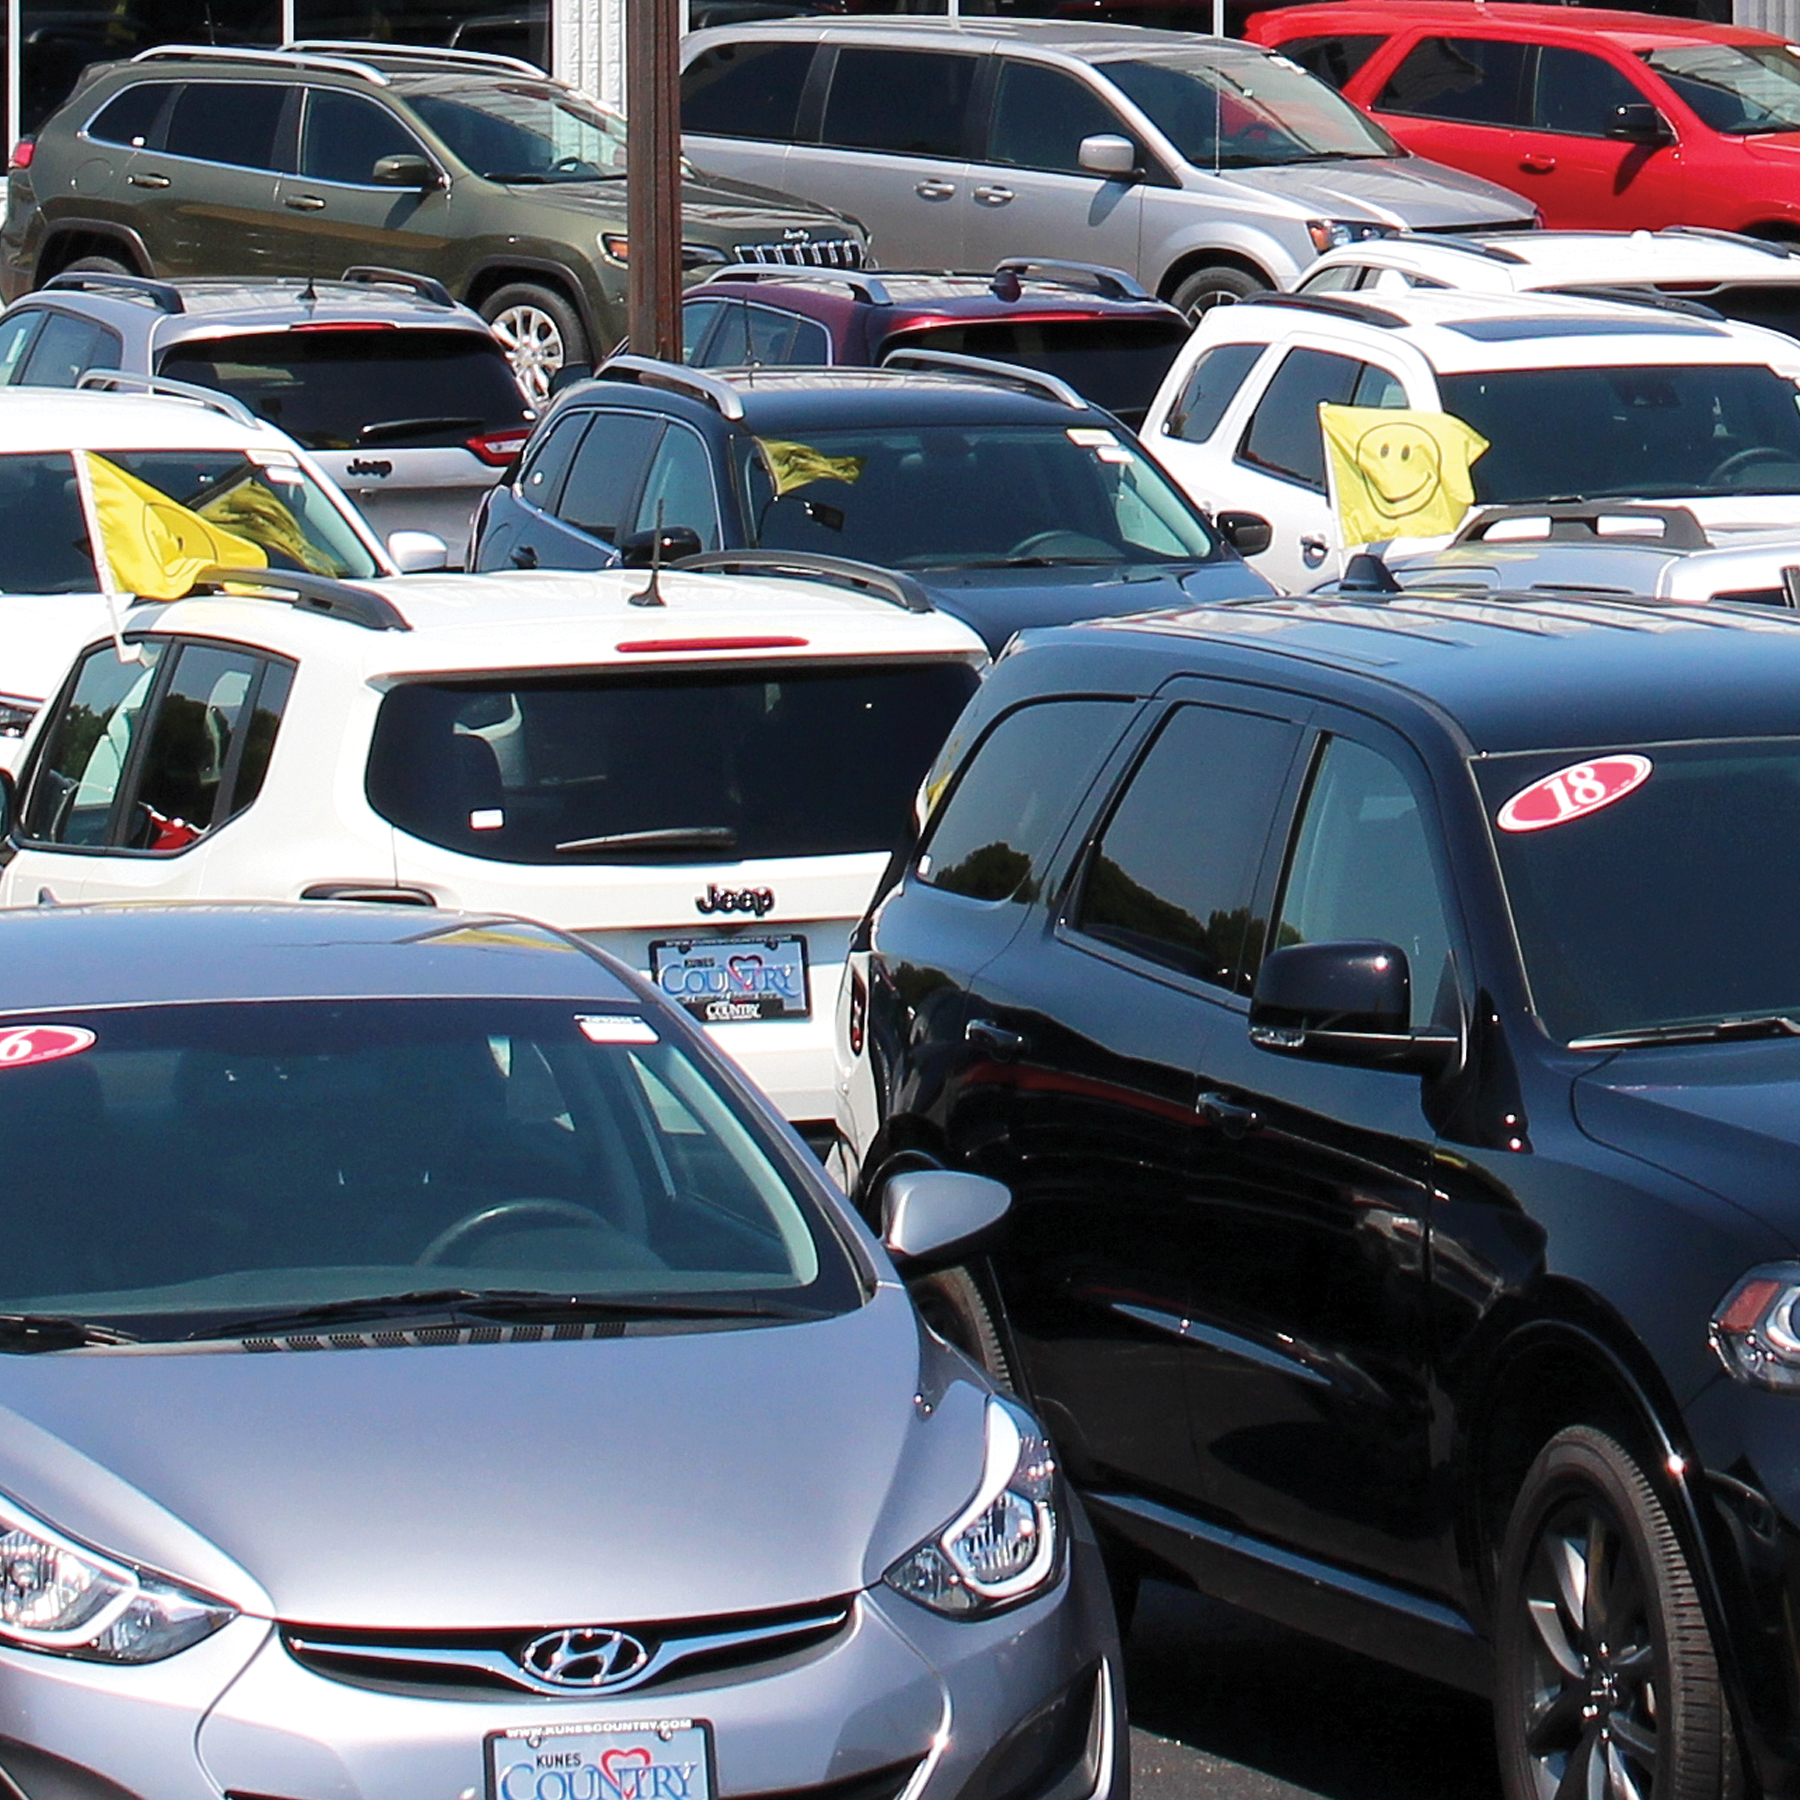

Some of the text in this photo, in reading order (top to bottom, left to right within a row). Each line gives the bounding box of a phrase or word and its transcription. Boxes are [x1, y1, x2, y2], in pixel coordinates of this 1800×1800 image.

[1542, 766, 1606, 816] 18
[694, 883, 775, 917] Jeep
[659, 964, 802, 997] COUNTRY
[505, 1717, 693, 1738] WWW.KUNESCOUNTRY.COM
[535, 1752, 582, 1769] KUNES
[499, 1761, 699, 1800] COUNTRY
